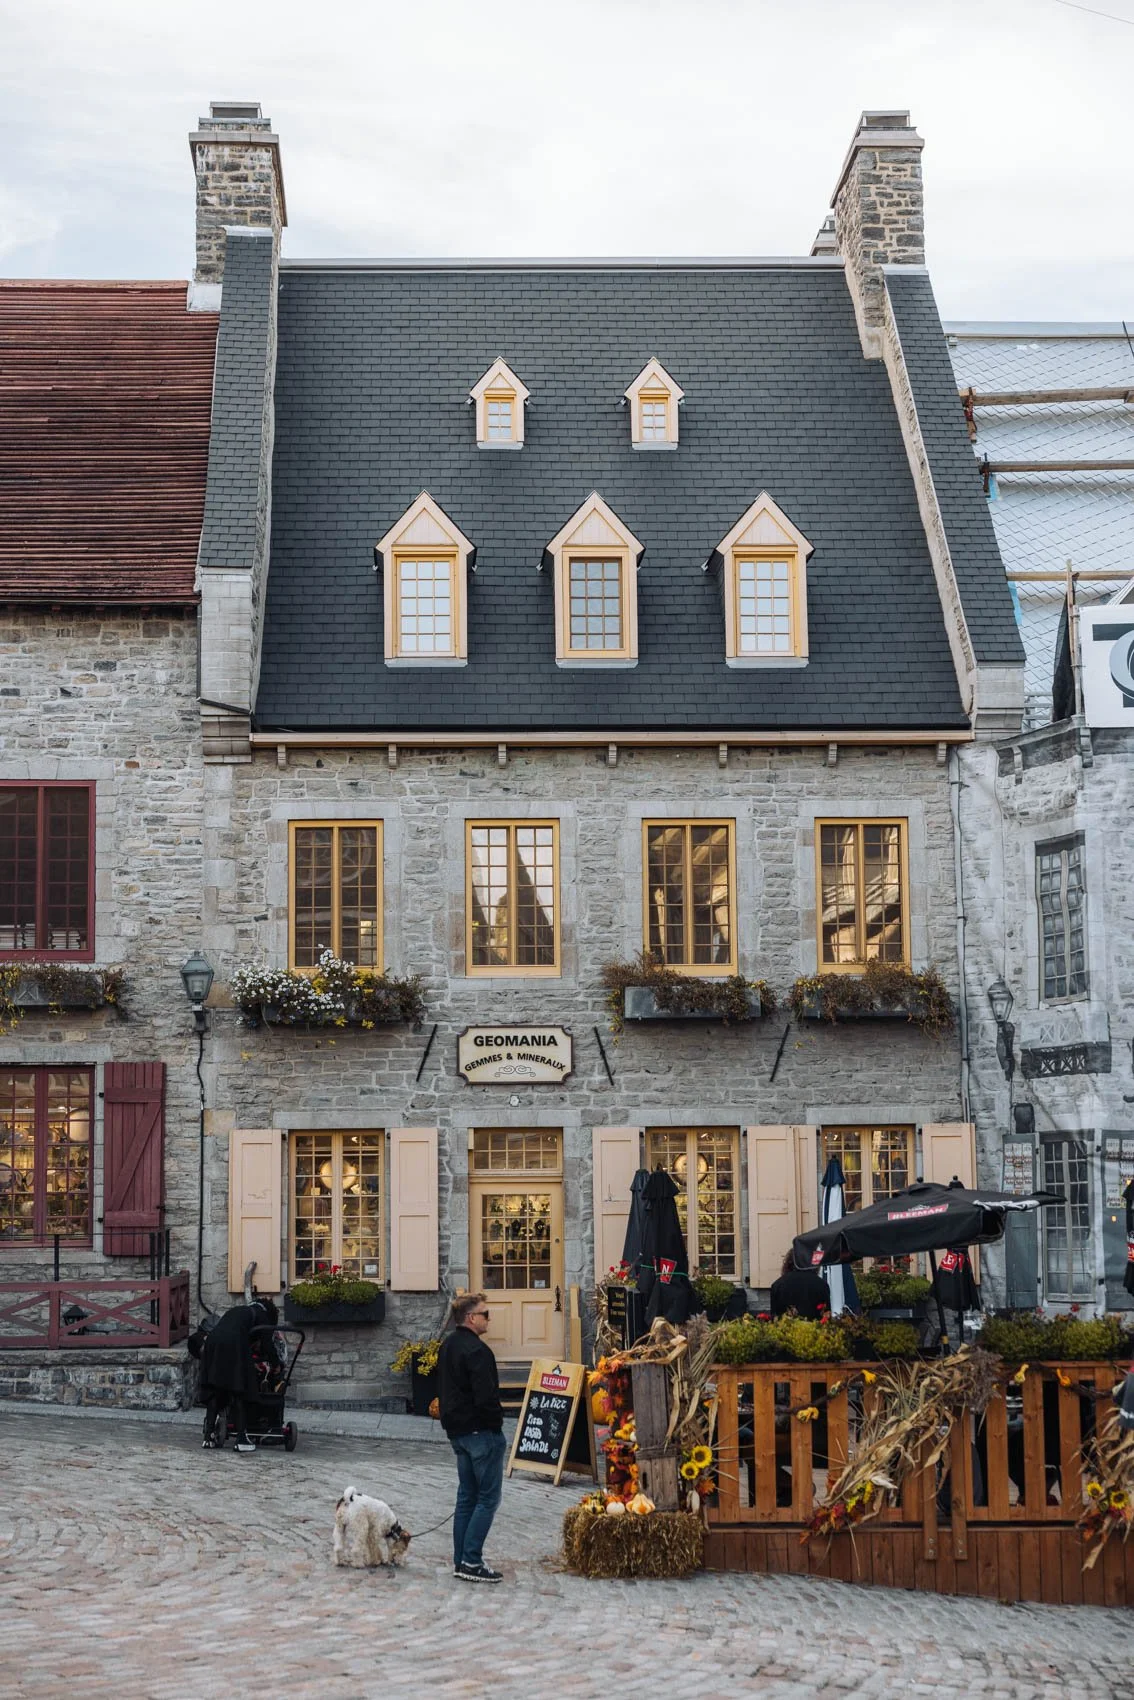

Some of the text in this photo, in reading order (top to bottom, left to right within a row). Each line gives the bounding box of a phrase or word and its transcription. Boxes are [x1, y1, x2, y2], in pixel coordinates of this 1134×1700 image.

[474, 1035, 558, 1046] GEOMANIA
[465, 1052, 565, 1071] GEMMES & MINERAUX
